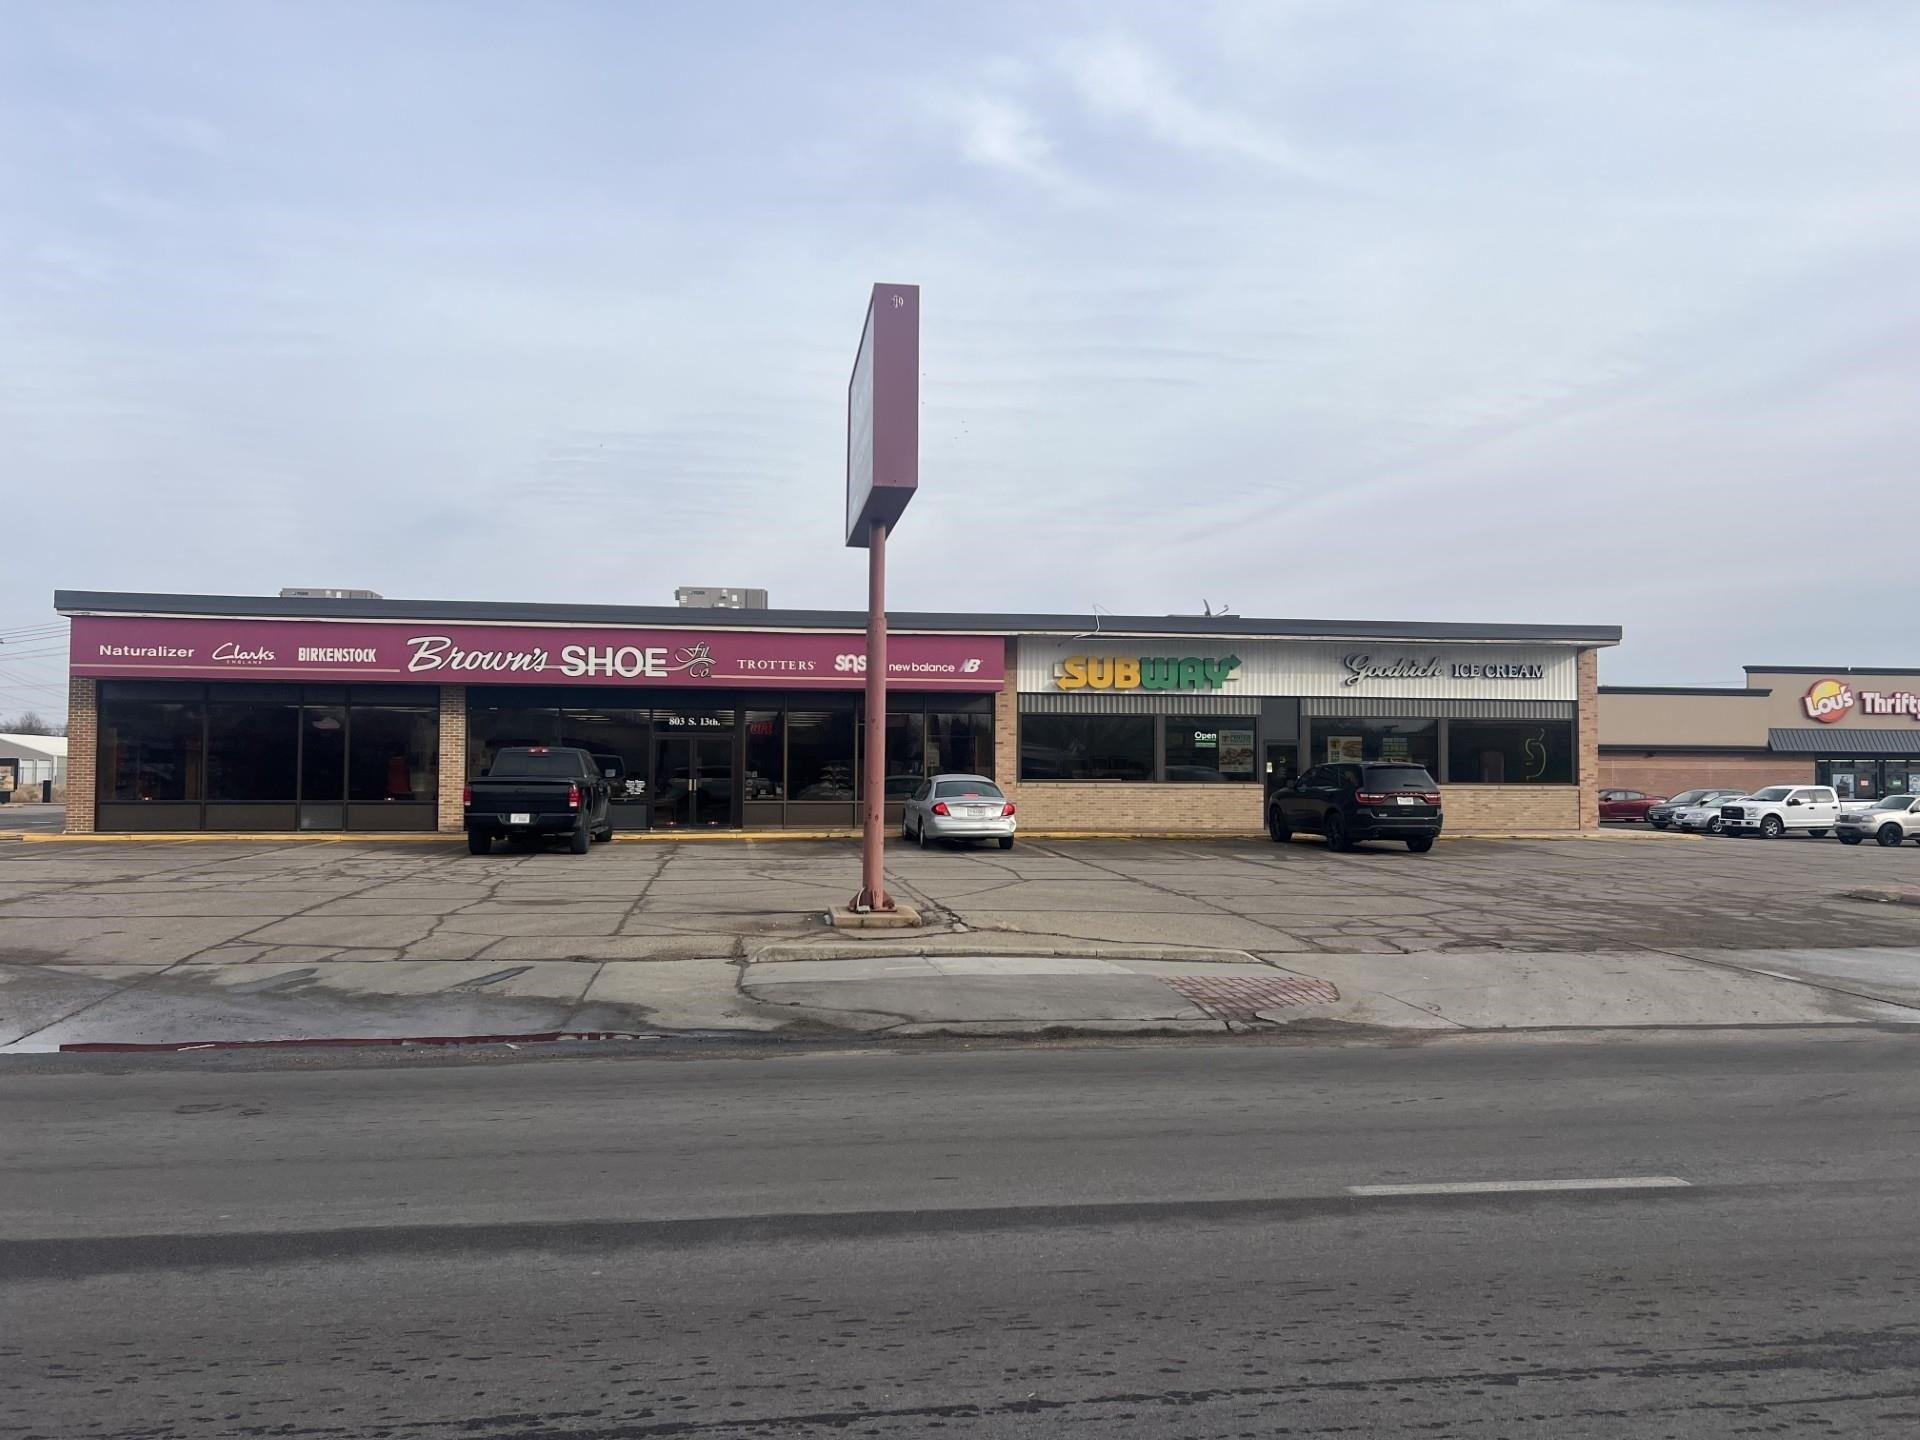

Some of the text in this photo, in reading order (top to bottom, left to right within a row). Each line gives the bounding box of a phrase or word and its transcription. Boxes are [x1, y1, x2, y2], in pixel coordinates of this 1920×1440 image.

[99, 644, 195, 657] Naturalizer
[211, 642, 275, 660] Clarks
[298, 647, 377, 663] BIRKENSTOCK
[406, 635, 668, 678] Brown's SHOE
[736, 659, 816, 671] TROTTERS
[834, 653, 867, 673] SAS
[888, 661, 956, 673] new balance
[1344, 653, 1545, 687] Goodrich ICE CREAM
[1056, 654, 1242, 691] SUBWAY
[668, 717, 685, 726] 803
[1194, 731, 1217, 741] Open
